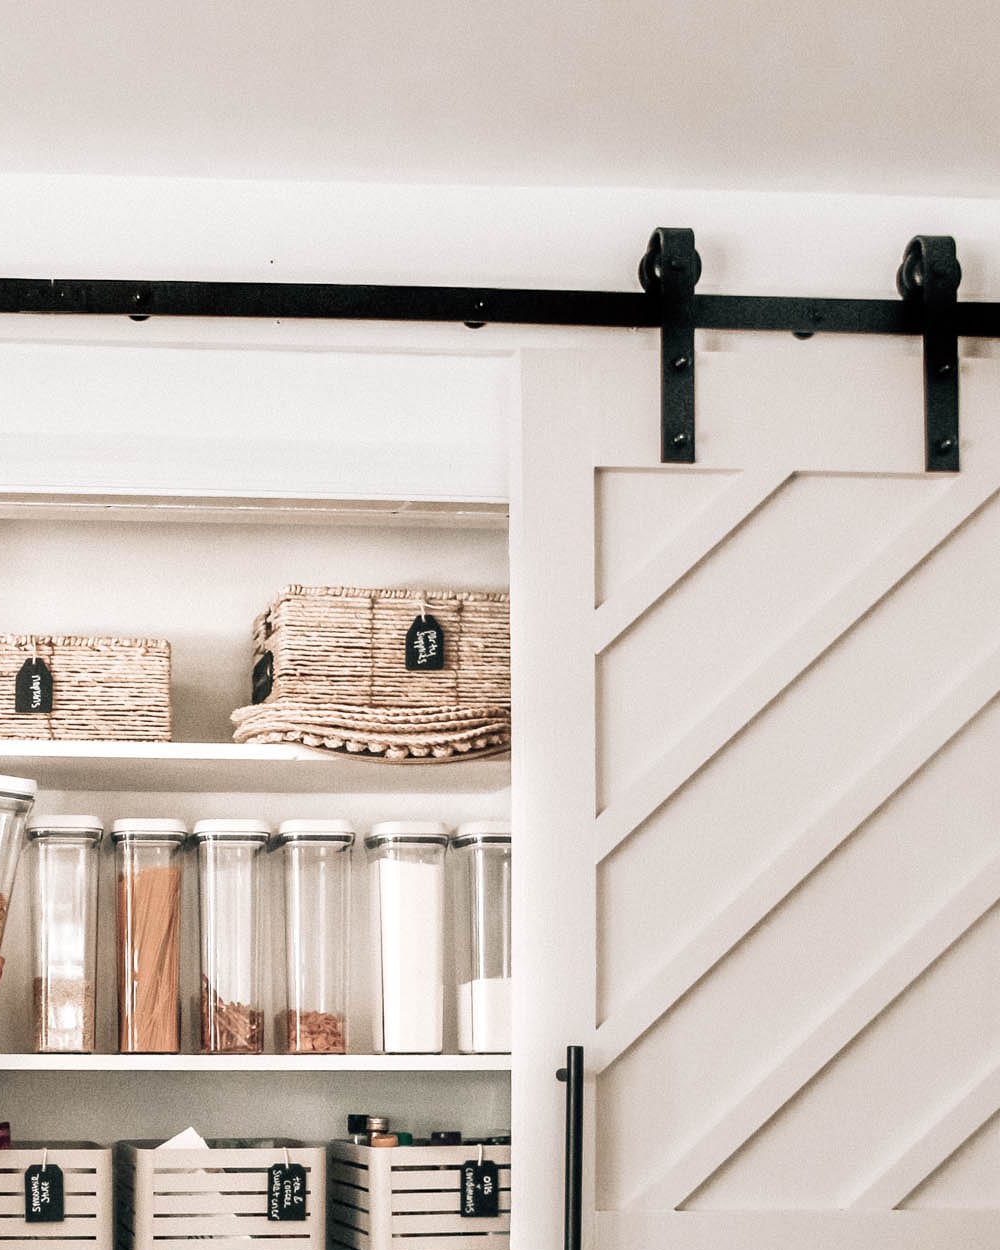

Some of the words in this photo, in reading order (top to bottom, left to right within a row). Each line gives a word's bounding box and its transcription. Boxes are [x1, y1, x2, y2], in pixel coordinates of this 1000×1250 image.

[413, 631, 428, 665] supplies
[425, 630, 438, 658] party
[29, 675, 41, 709] napkins
[283, 1180, 292, 1208] coffee
[292, 1177, 300, 1193] tea
